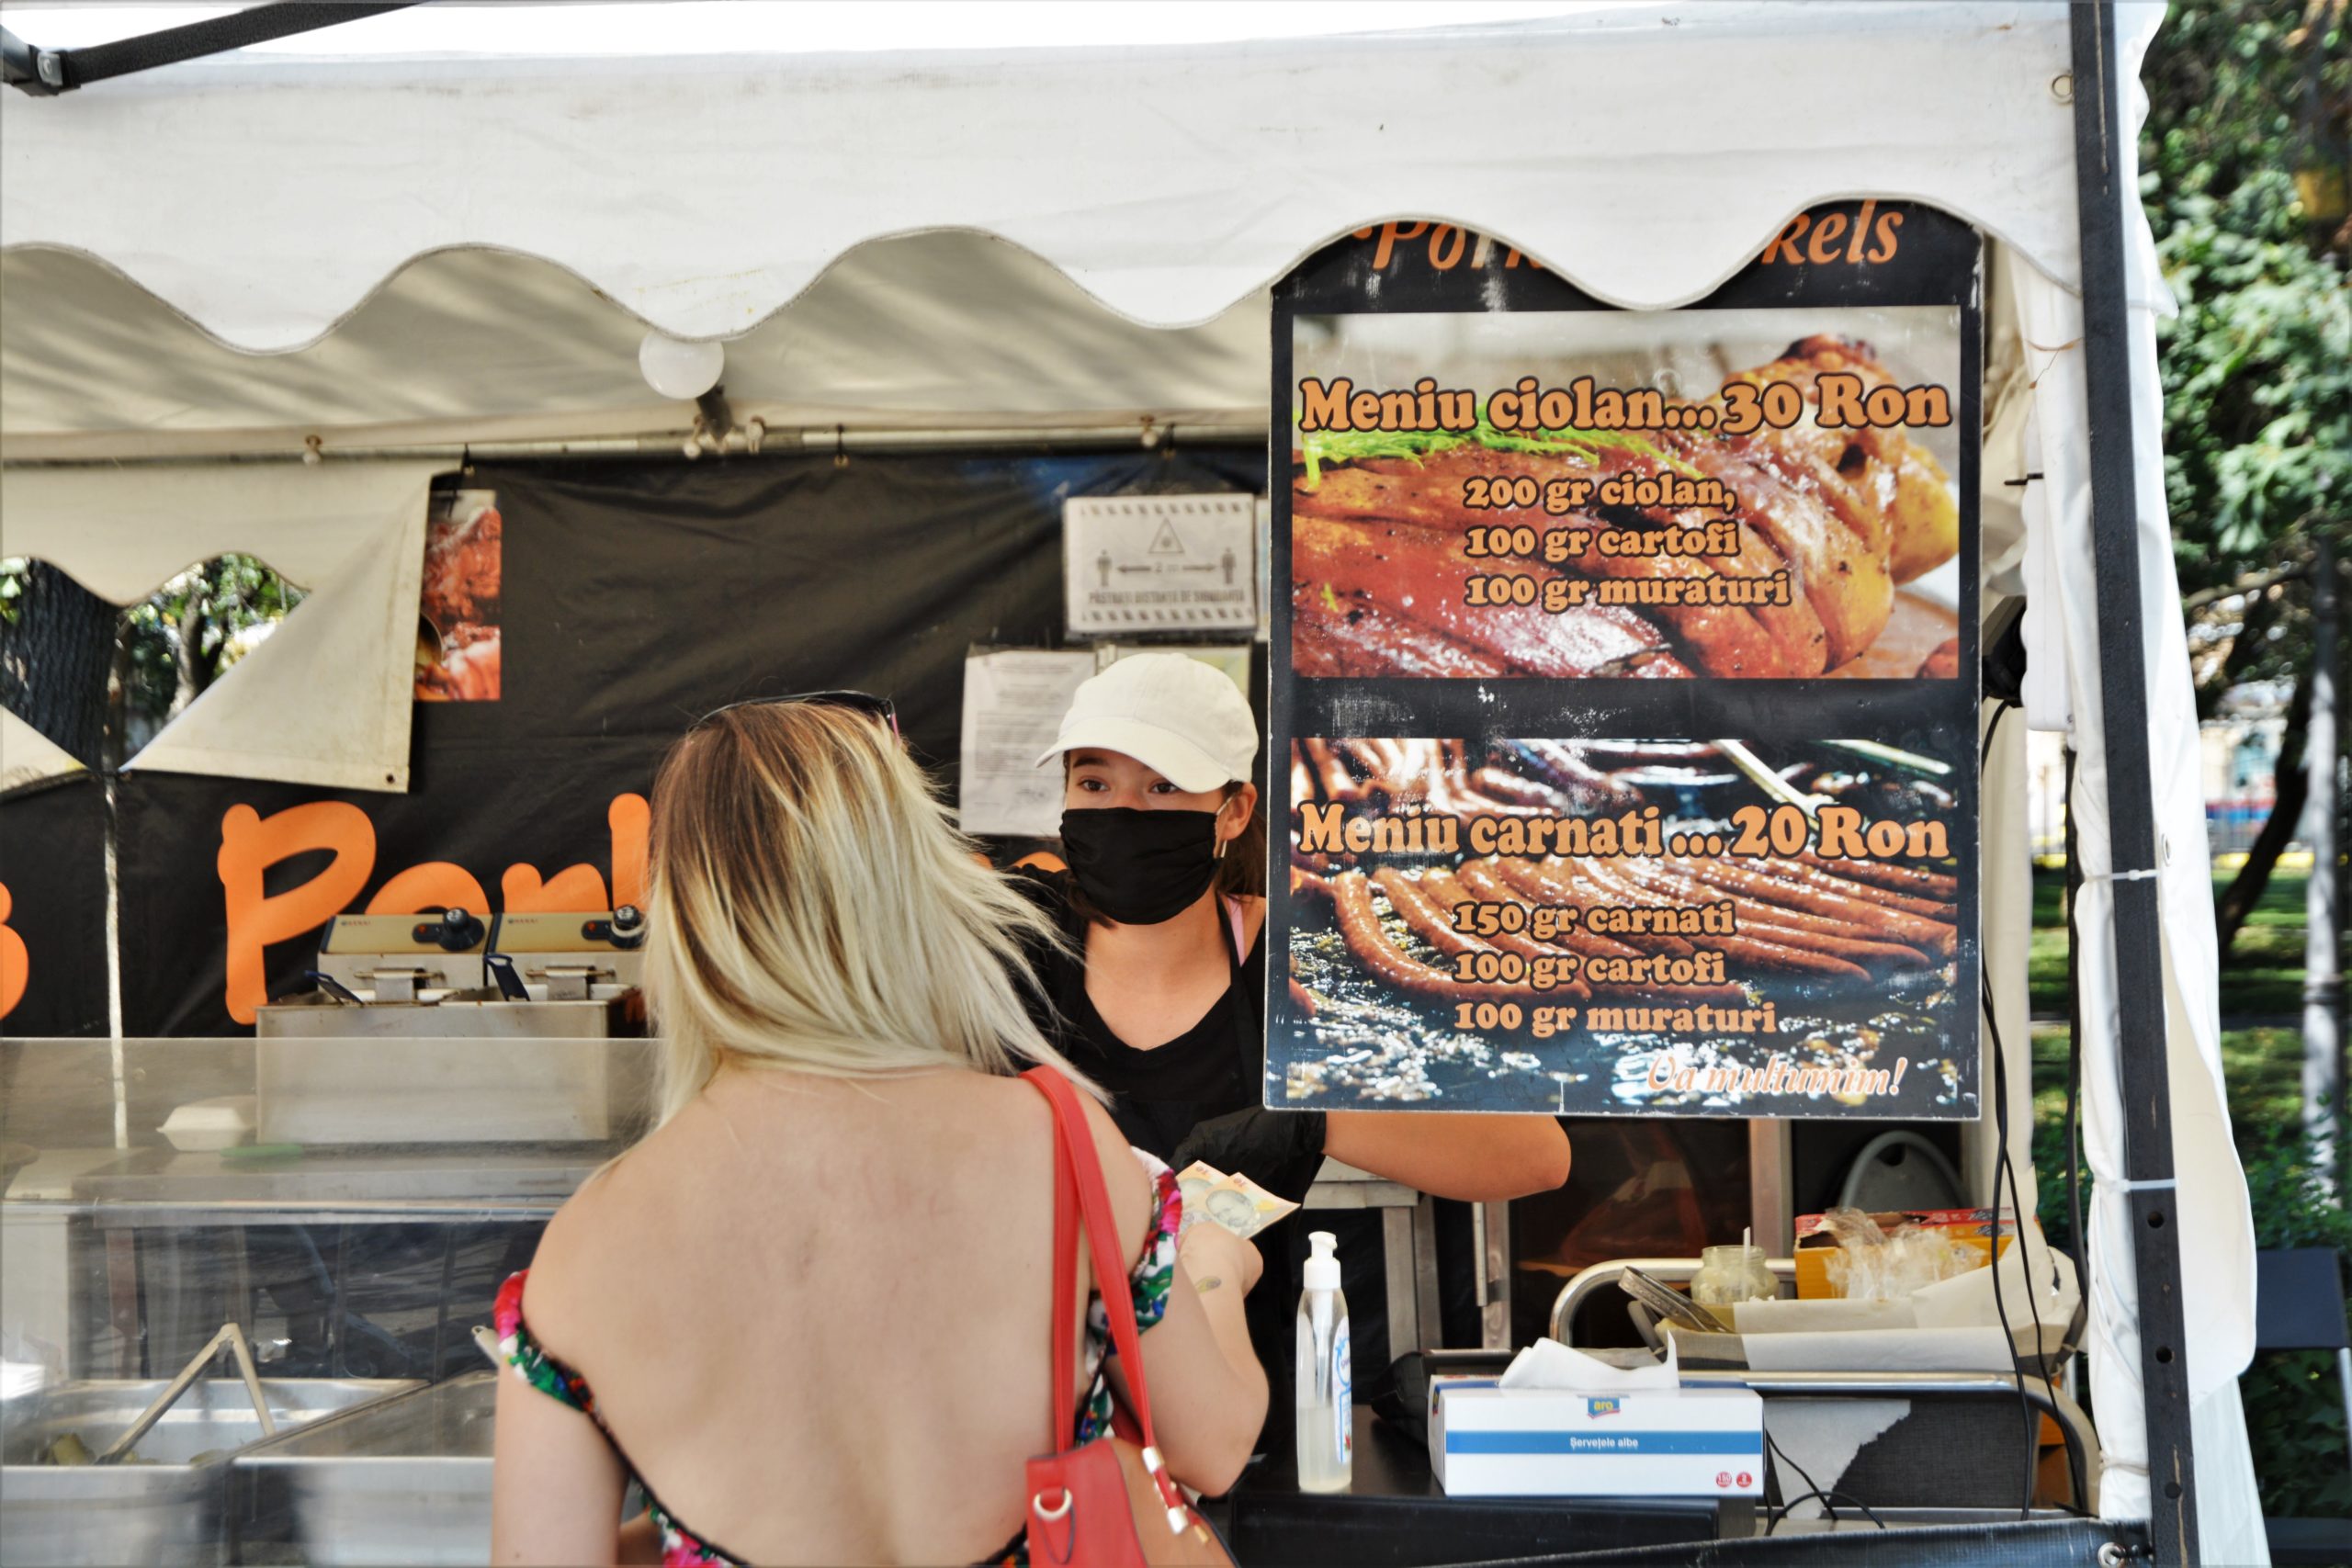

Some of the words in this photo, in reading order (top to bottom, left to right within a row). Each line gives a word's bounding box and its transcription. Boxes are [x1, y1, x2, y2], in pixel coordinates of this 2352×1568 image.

[1299, 377, 1476, 431] Meniu
[1815, 373, 1952, 429] Ron
[1464, 477, 1538, 509] 200
[1544, 479, 1592, 514] gr
[1599, 472, 1736, 513] ciolan,
[1465, 526, 1537, 557] 100
[1544, 528, 1591, 562] gr
[1598, 521, 1740, 558] cartofi
[1465, 576, 1537, 606] 100
[1543, 577, 1591, 613] gr
[1598, 570, 1792, 606] muraturi
[1298, 802, 1461, 854] Meniu
[1816, 805, 1951, 859] Ron
[1454, 903, 1525, 936] 150
[1532, 905, 1579, 941] gr
[1585, 901, 1736, 935] carnati
[1454, 953, 1524, 982] 100
[1531, 954, 1579, 989] gr
[1584, 950, 1727, 985] cartofi
[1453, 1002, 1523, 1030] 100
[1531, 1004, 1578, 1039] gr
[1585, 1001, 1778, 1034] muraturi
[1704, 1055, 1908, 1097] multumim!
[1594, 1401, 1614, 1411] aro
